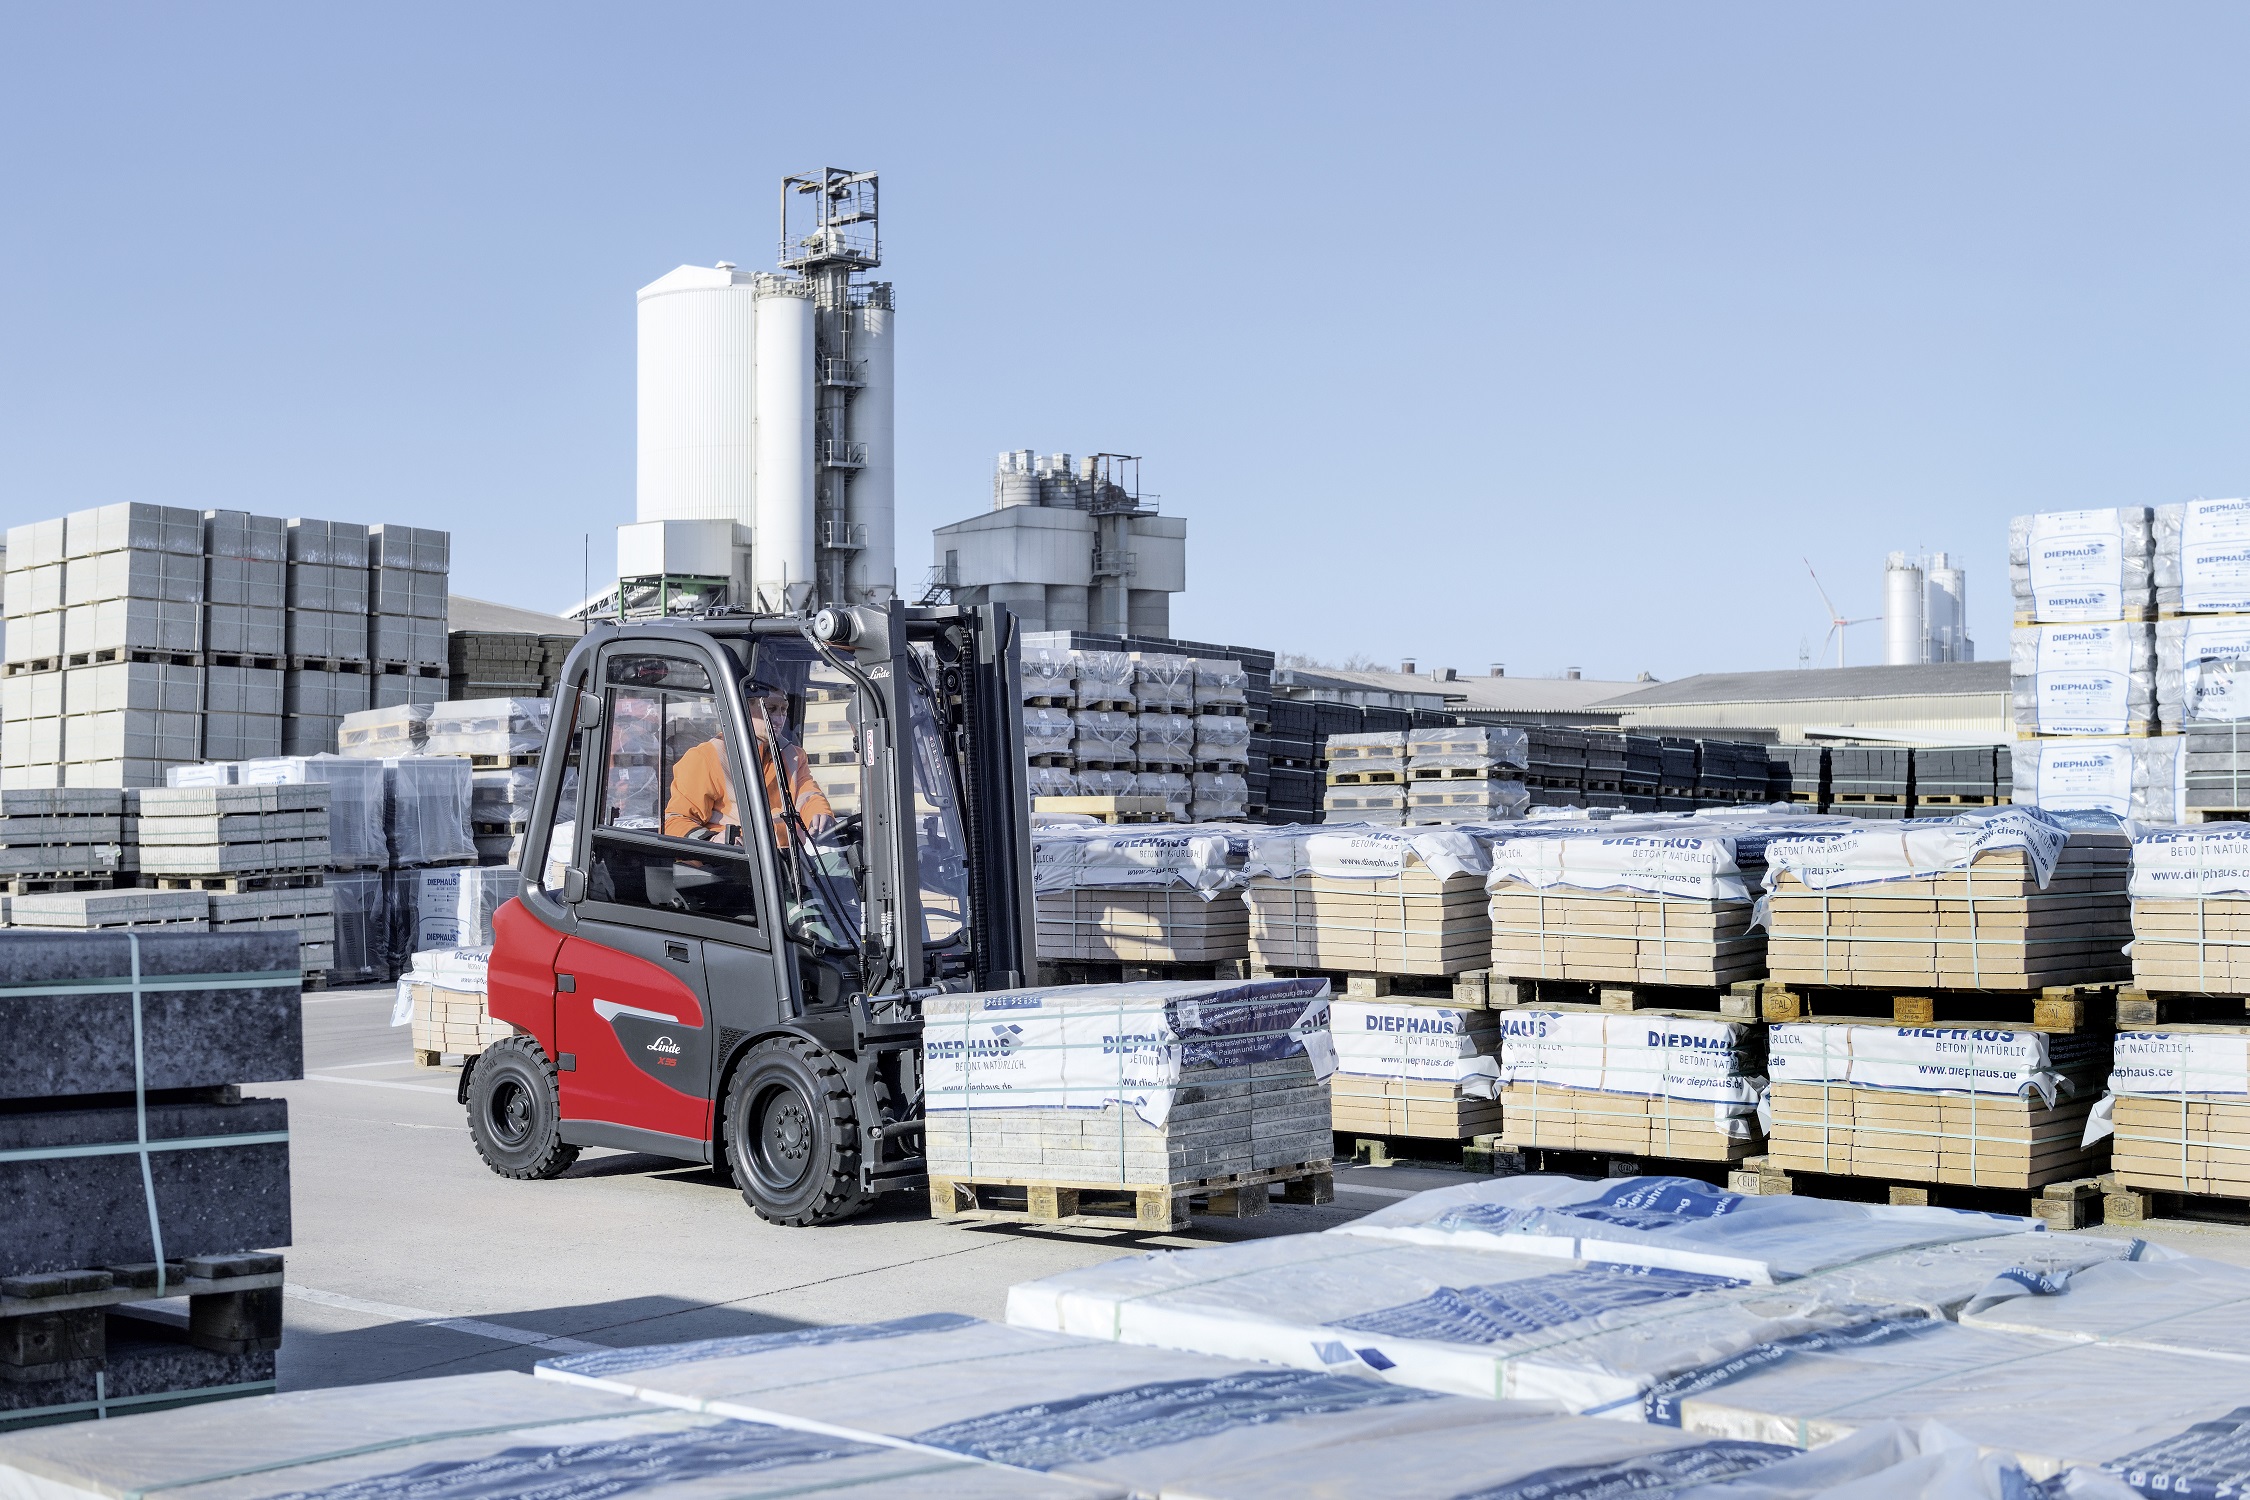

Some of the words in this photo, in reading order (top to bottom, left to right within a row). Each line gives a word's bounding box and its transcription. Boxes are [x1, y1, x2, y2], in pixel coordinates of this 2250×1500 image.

[2044, 548, 2097, 559] DIEPHAUS
[2049, 597, 2099, 606] DIEPHAUS
[2053, 632, 2102, 641] DIEPHAUS
[2201, 646, 2250, 654] DIEPHAU
[866, 666, 891, 680] Linde
[2053, 760, 2104, 769] DIEPHAUS
[1632, 849, 1667, 859] BETONT
[1773, 846, 1804, 857] BETONT
[1975, 826, 2050, 872] www.diephaus.de
[427, 878, 457, 886] DIEPHAUS
[426, 933, 457, 942] DIEPHAUS
[1366, 1014, 1454, 1034] DIEPHAUS
[1897, 1028, 2015, 1043] DIEPHAUS
[646, 1036, 681, 1055] Linde
[927, 1038, 1011, 1060] DIEPHAUS
[1976, 1043, 2027, 1057] NATÜRLIC
[2129, 1041, 2194, 1054] NATÜRLICH.
[955, 1060, 982, 1072] BETONT
[1381, 1057, 1455, 1068] www.iephaus.de
[1679, 1055, 1710, 1067] BETONT
[1742, 1175, 1758, 1188] EUR
